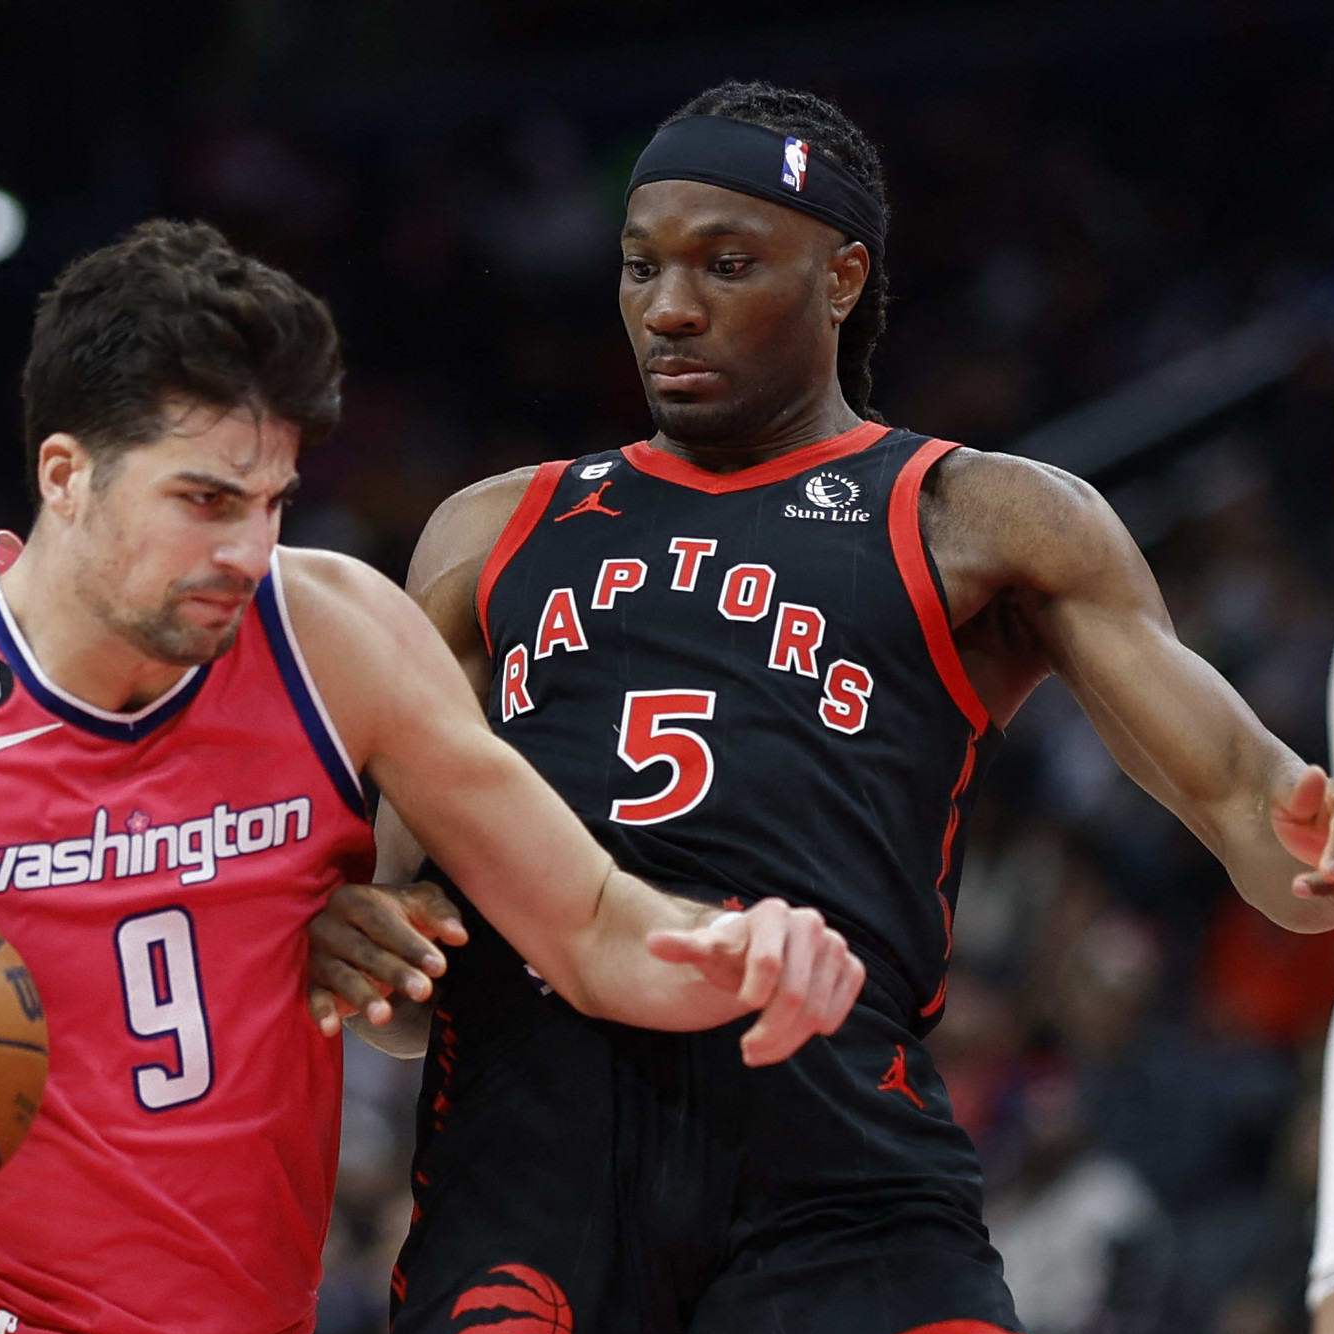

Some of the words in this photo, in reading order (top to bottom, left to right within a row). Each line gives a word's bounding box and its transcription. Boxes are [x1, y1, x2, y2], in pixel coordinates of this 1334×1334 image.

[579, 461, 613, 480] 6
[784, 504, 825, 519] Sun
[831, 508, 870, 522] Life
[502, 537, 873, 735] RAPTORS
[609, 688, 716, 826] 5
[116, 904, 214, 1114] 9
